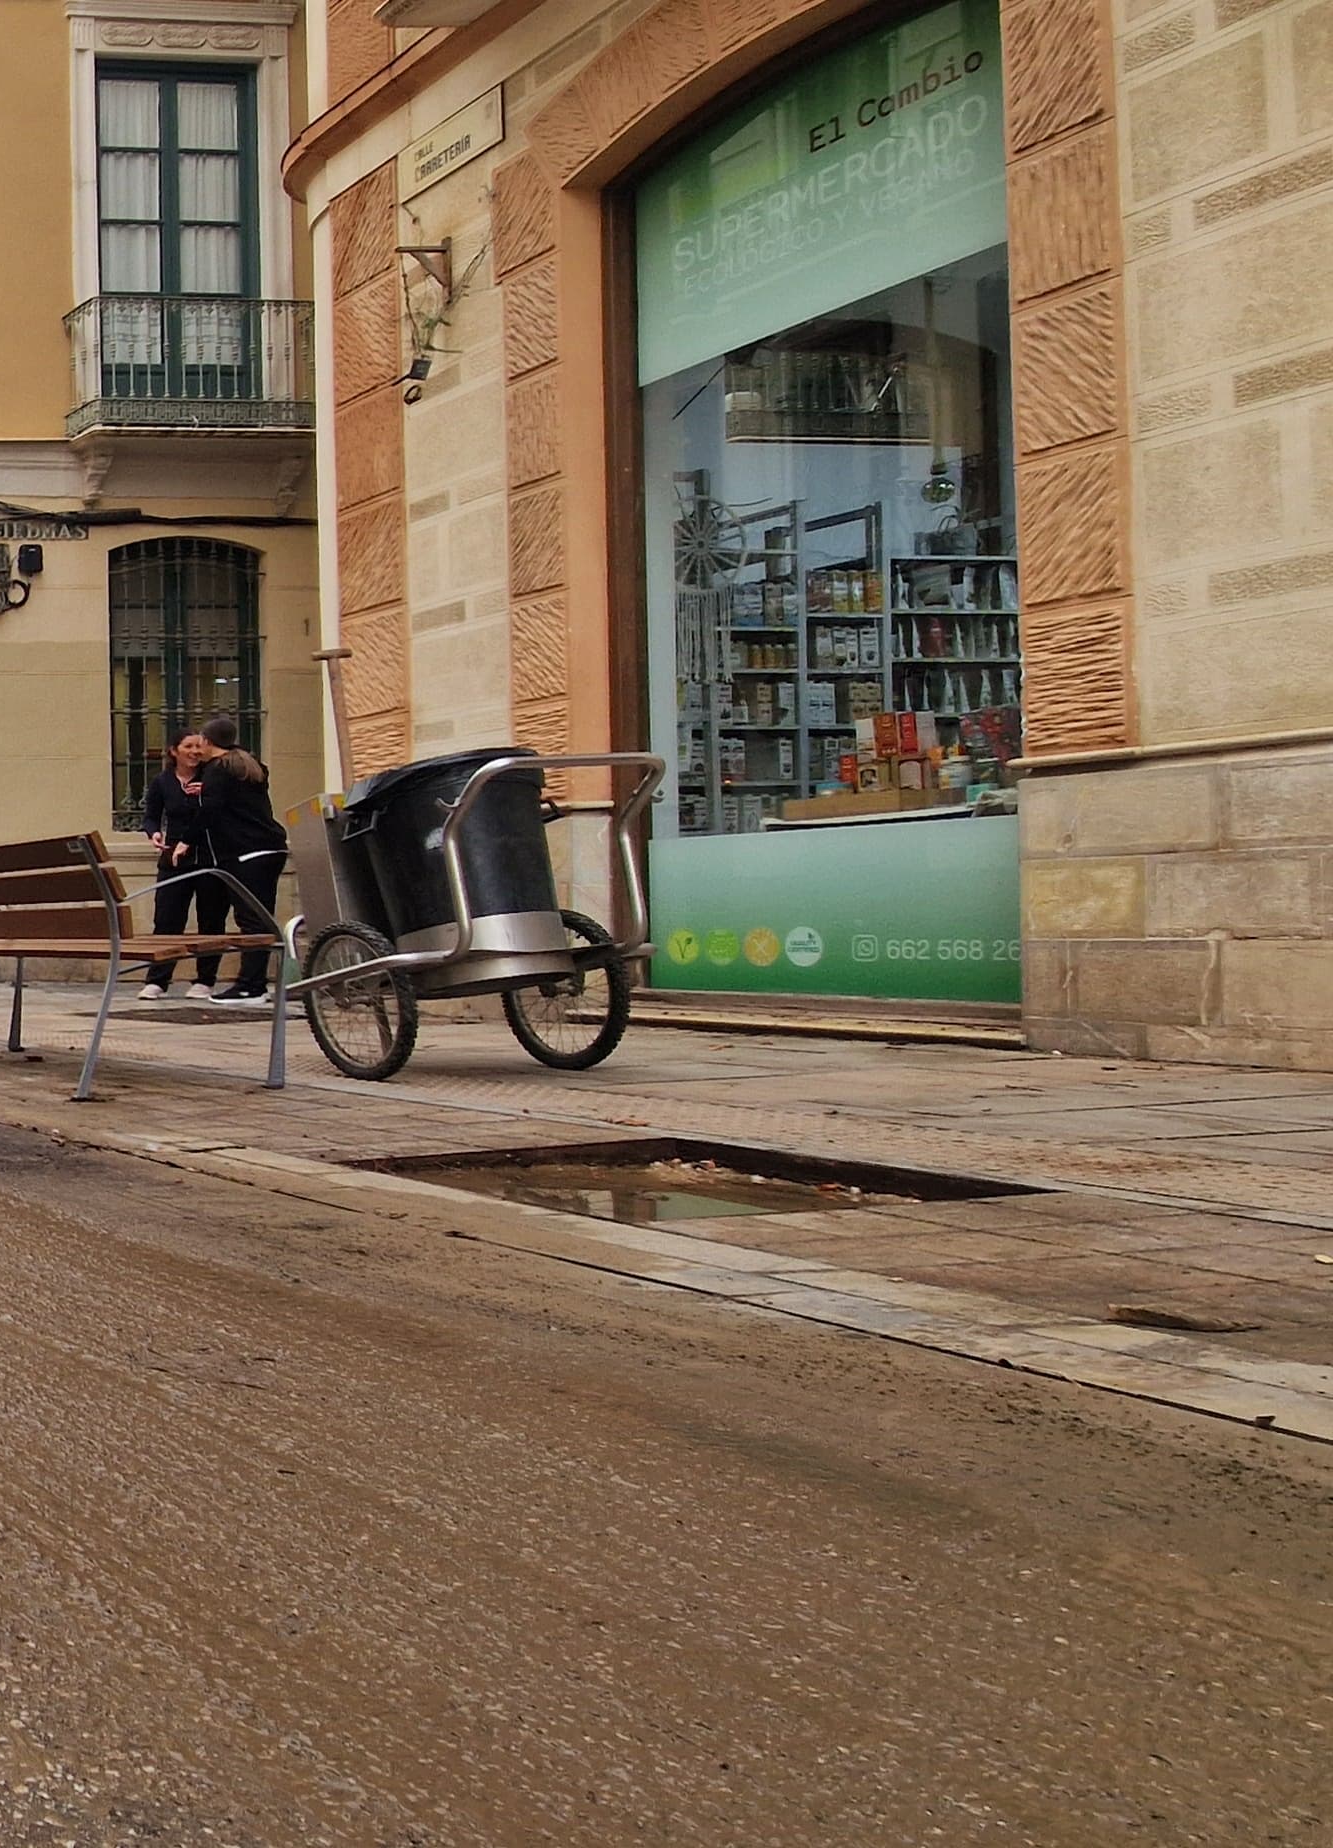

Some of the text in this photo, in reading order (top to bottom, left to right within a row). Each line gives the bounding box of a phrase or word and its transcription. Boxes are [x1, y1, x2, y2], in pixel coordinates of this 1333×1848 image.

[808, 50, 984, 153] El Cambio
[414, 141, 433, 162] CALLE
[673, 94, 987, 272] SUPERMERCADO
[886, 939, 931, 960] 662
[937, 939, 984, 961] 568
